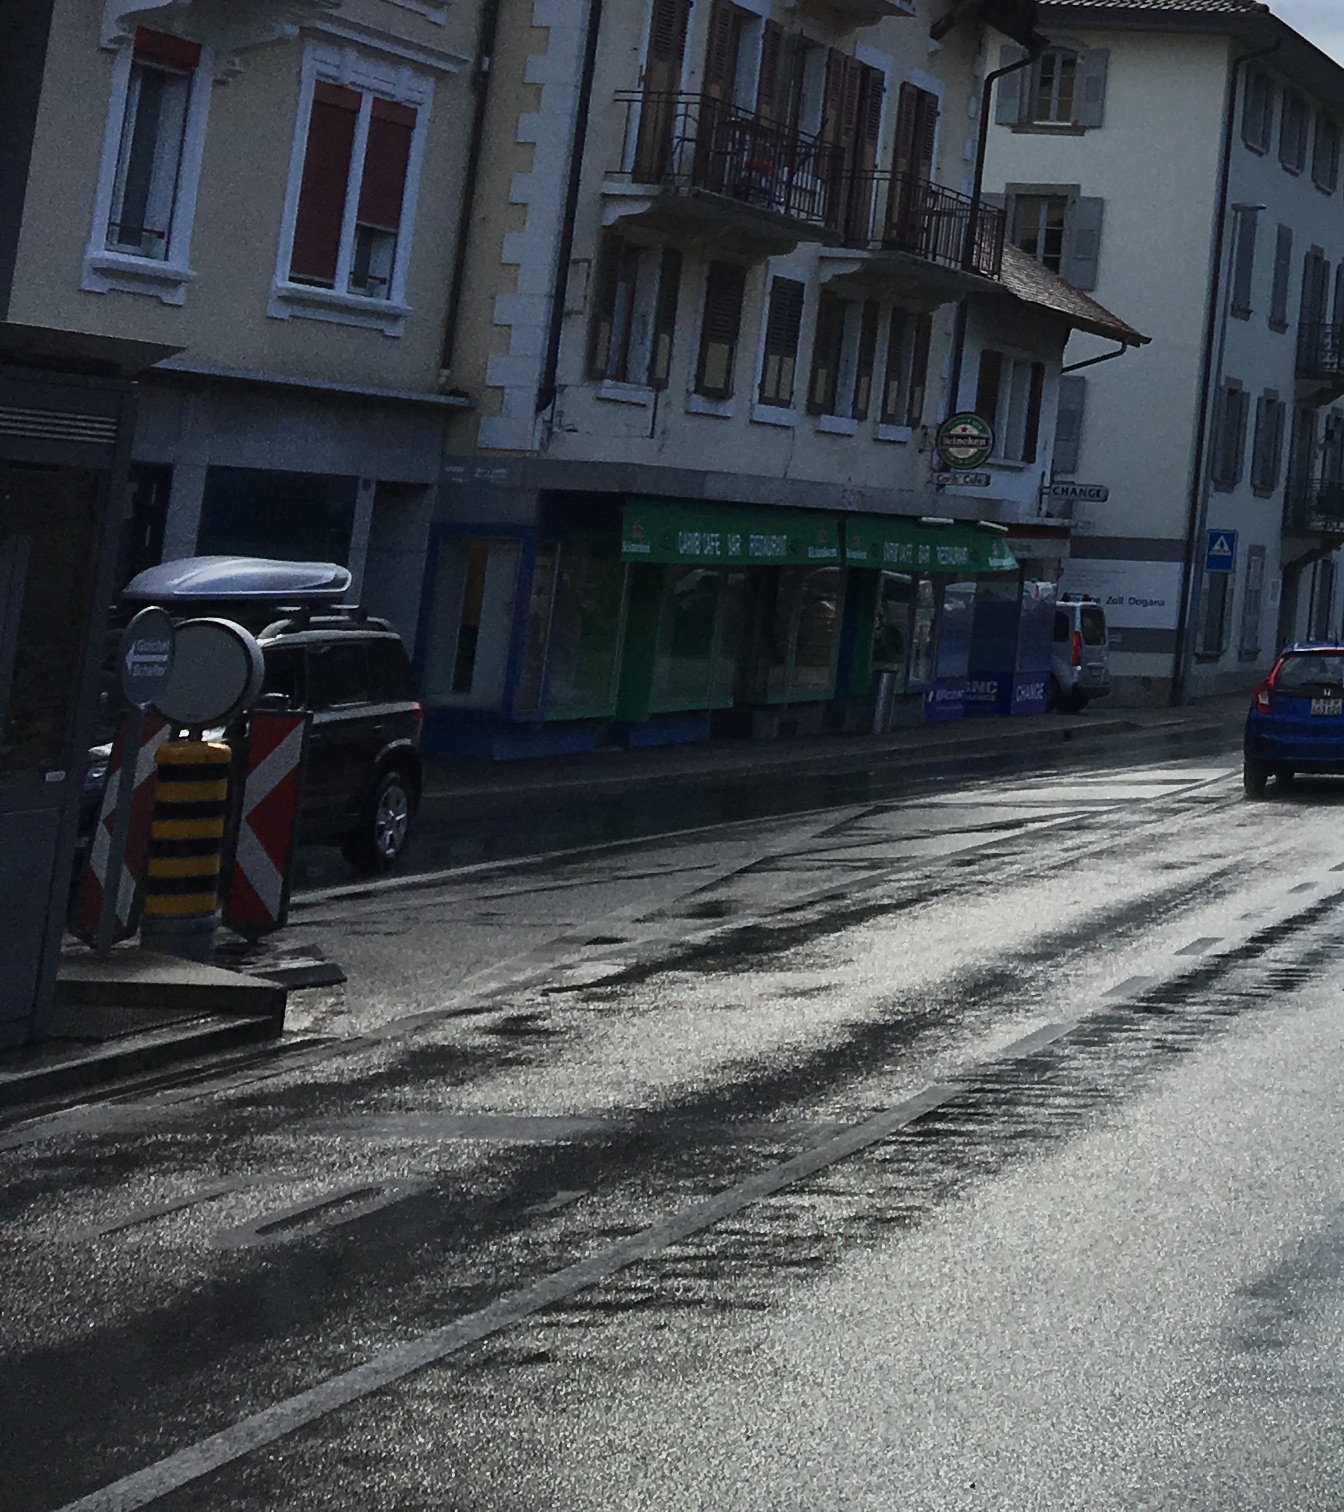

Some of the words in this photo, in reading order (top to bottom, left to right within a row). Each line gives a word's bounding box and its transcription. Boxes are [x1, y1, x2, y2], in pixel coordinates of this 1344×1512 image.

[943, 436, 986, 446] Heineken
[1052, 486, 1102, 498] CHANGE
[1106, 595, 1124, 605] Zoll
[1128, 596, 1165, 607] Dogana
